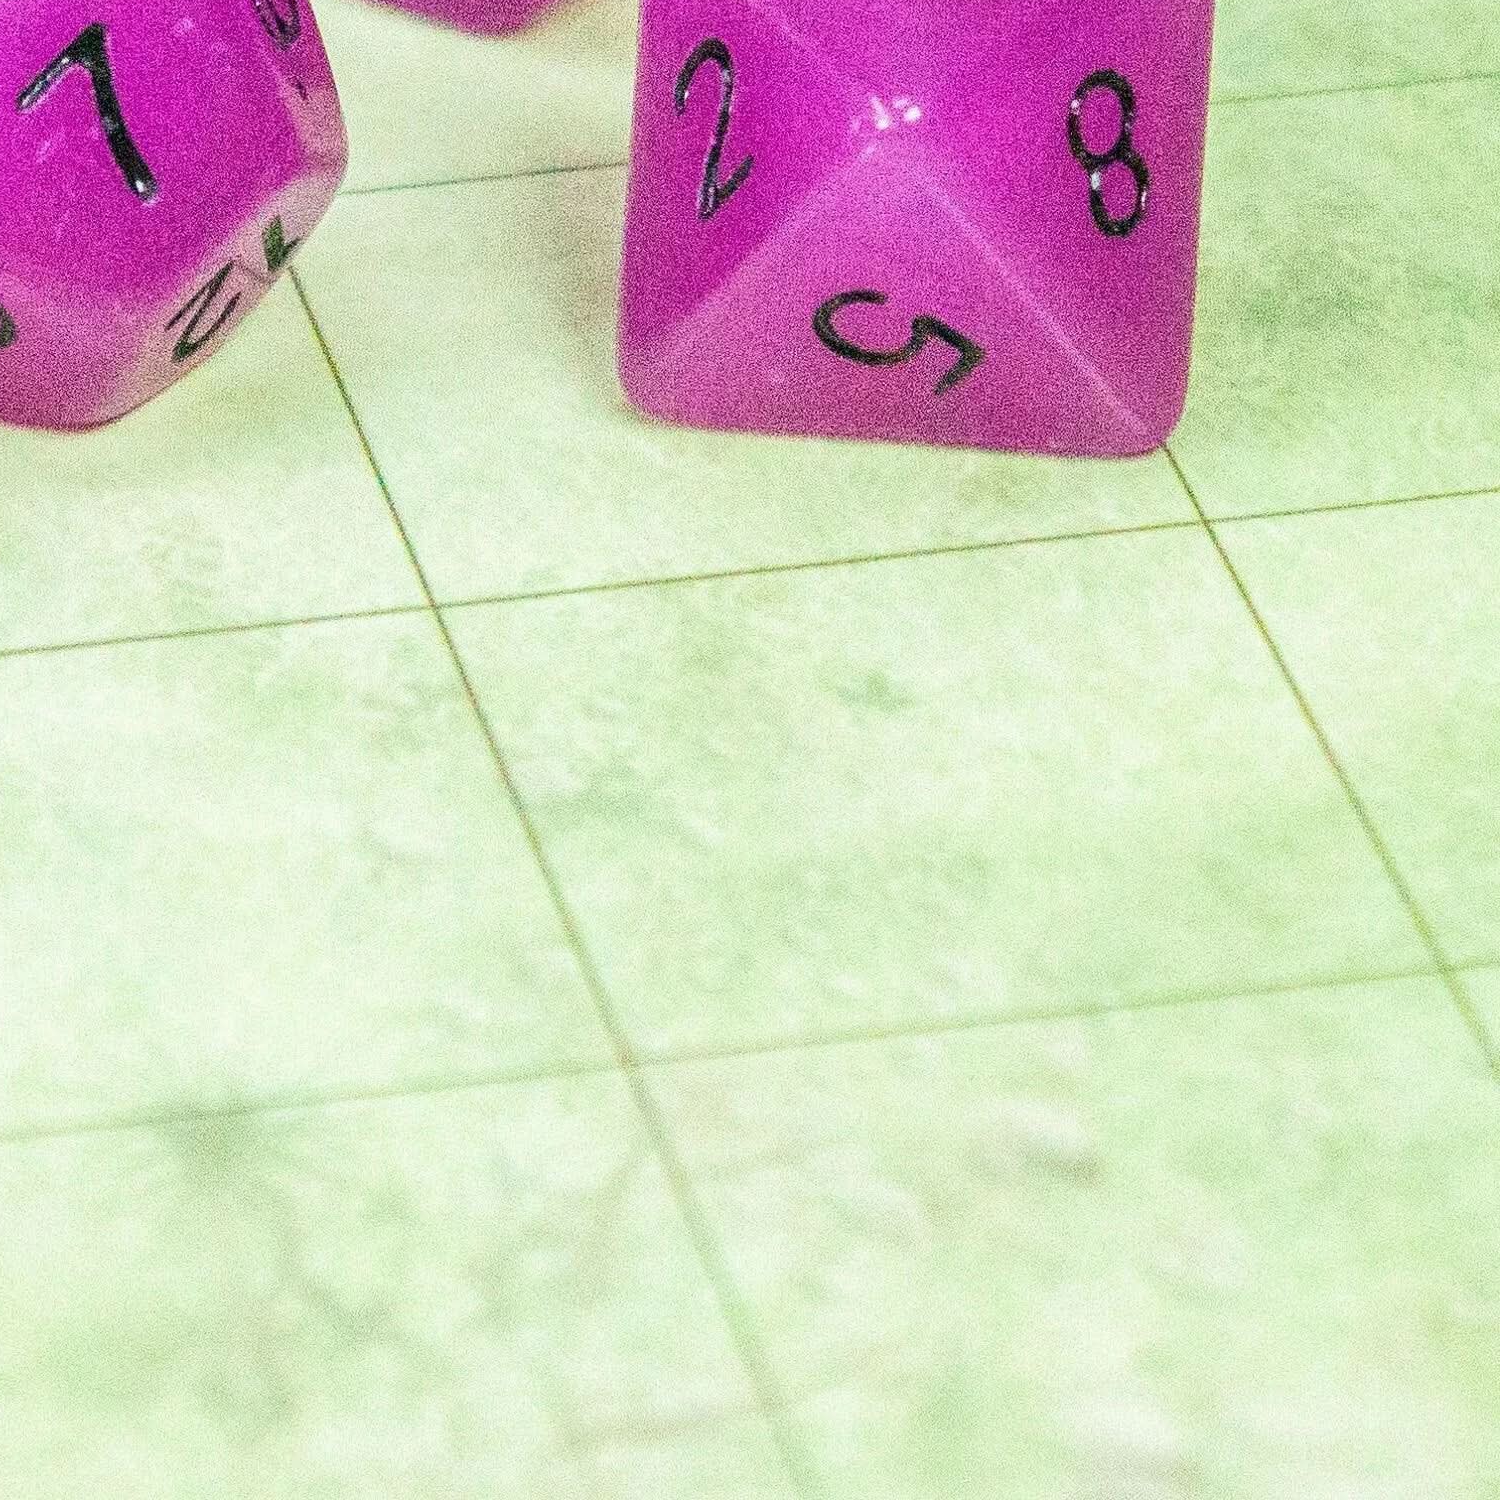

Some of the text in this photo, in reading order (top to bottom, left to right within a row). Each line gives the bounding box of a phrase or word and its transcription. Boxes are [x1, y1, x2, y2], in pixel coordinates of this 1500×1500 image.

[16, 22, 160, 208] 7
[673, 36, 756, 222] 2
[1066, 68, 1152, 240] 8
[810, 288, 986, 398] 5
